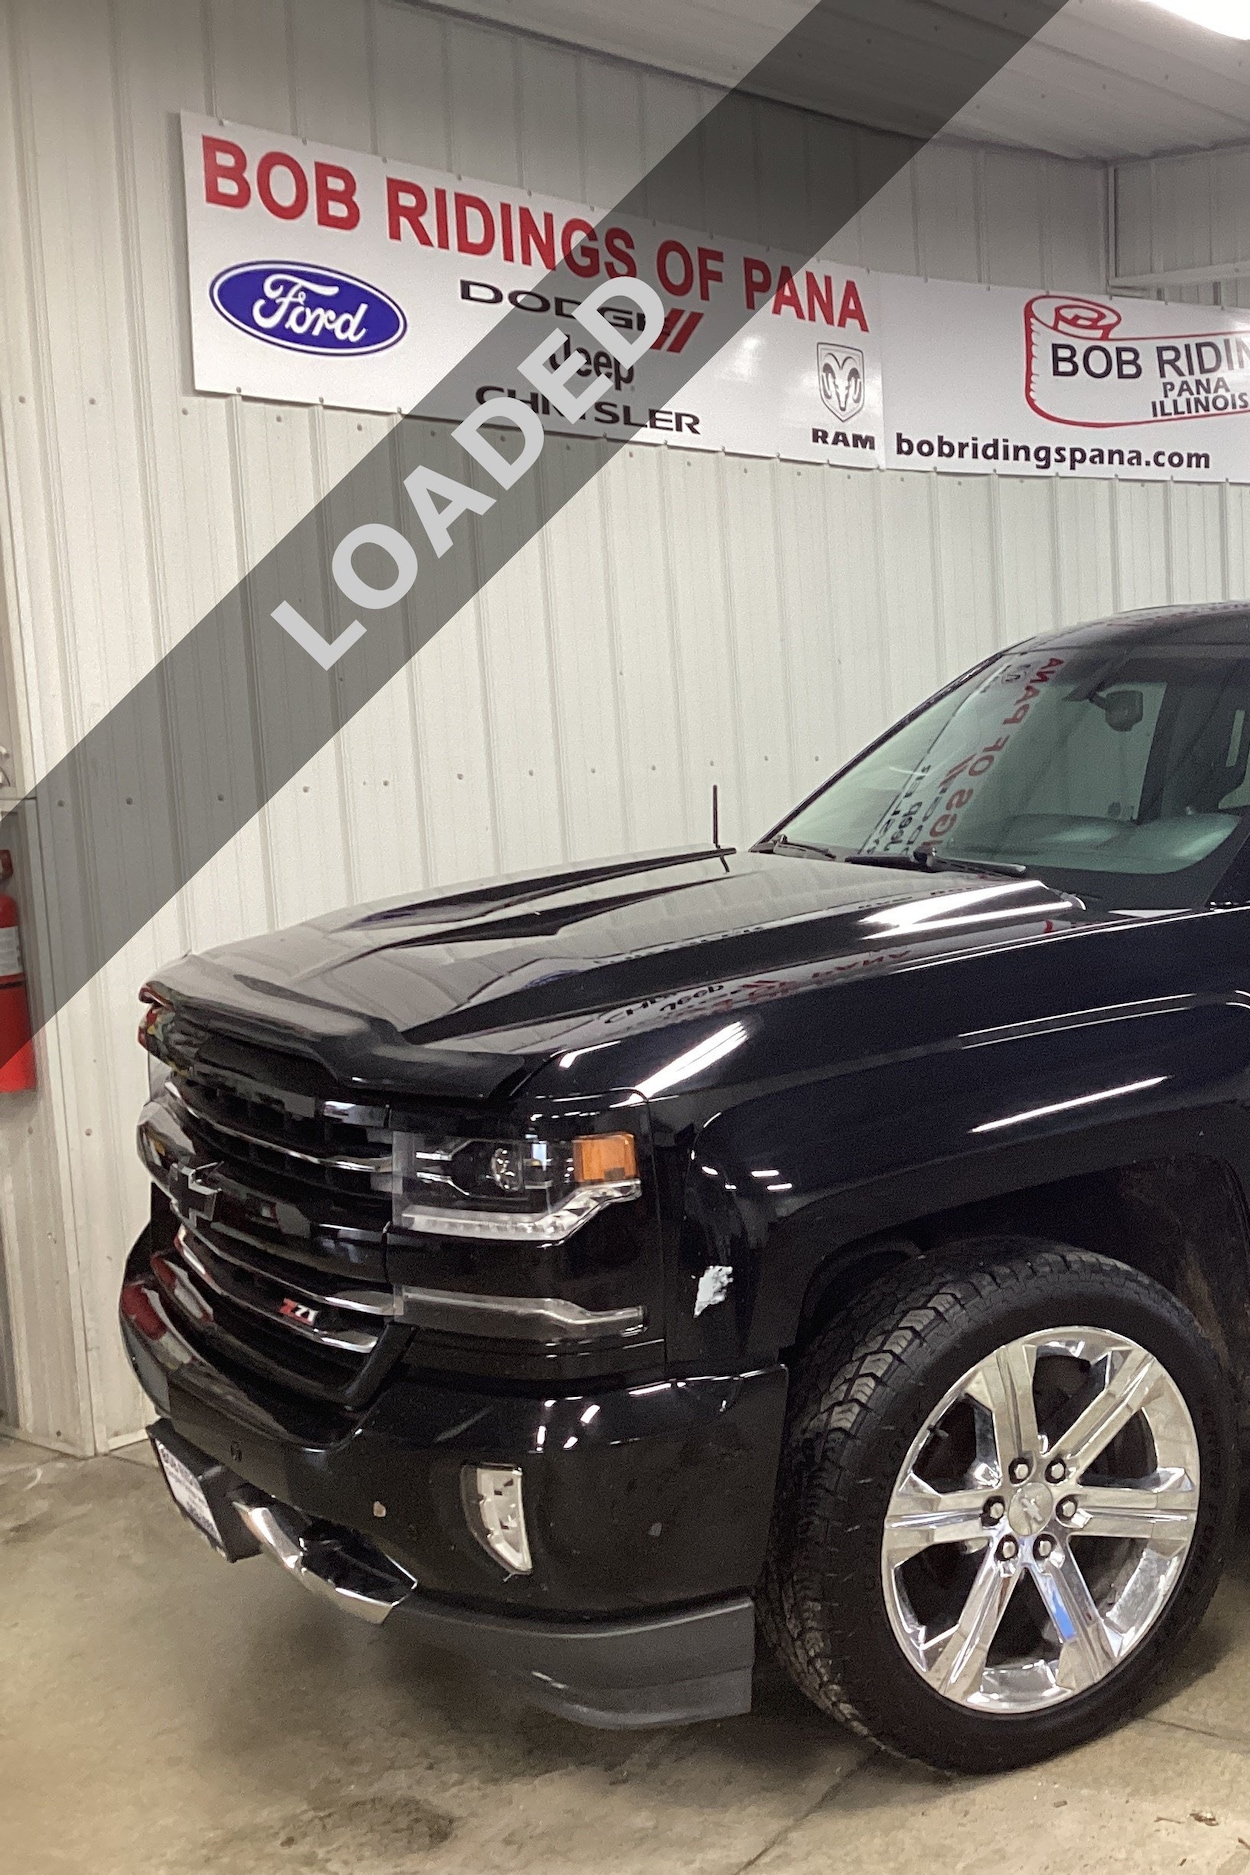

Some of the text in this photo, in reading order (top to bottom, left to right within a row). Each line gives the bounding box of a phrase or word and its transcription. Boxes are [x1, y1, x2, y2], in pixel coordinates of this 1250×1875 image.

[201, 135, 869, 333] BOB RIDINGS OF PANA
[253, 272, 370, 344] Ford
[1051, 342, 1143, 379] BOB
[1151, 392, 1250, 418] ILLINOIS
[1162, 376, 1231, 399] PANA
[475, 385, 701, 435] CHSLER
[811, 427, 876, 451] RAM
[895, 432, 1211, 471] bobridingspana.com
[280, 1298, 319, 1326] Z71
